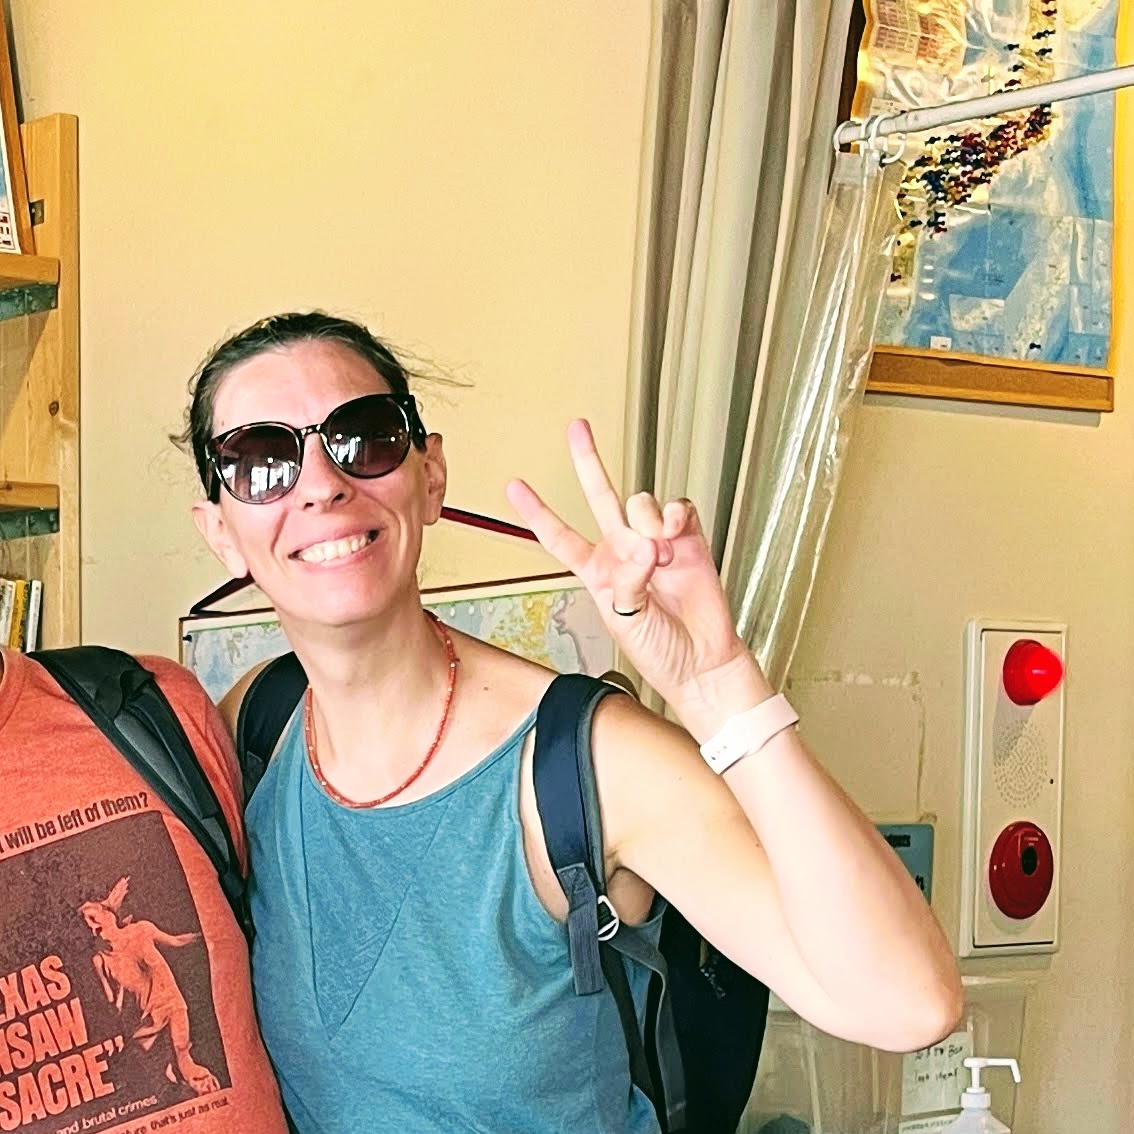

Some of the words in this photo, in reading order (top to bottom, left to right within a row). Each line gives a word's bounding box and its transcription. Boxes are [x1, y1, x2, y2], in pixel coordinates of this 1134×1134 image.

[3, 825, 36, 851] will
[34, 819, 58, 841] be
[56, 808, 85, 834] left
[83, 801, 100, 824] of
[99, 790, 151, 818] them?
[81, 1106, 117, 1130] brutal
[117, 1094, 159, 1117] crimes
[177, 1105, 197, 1124] just
[197, 1102, 210, 1116] as
